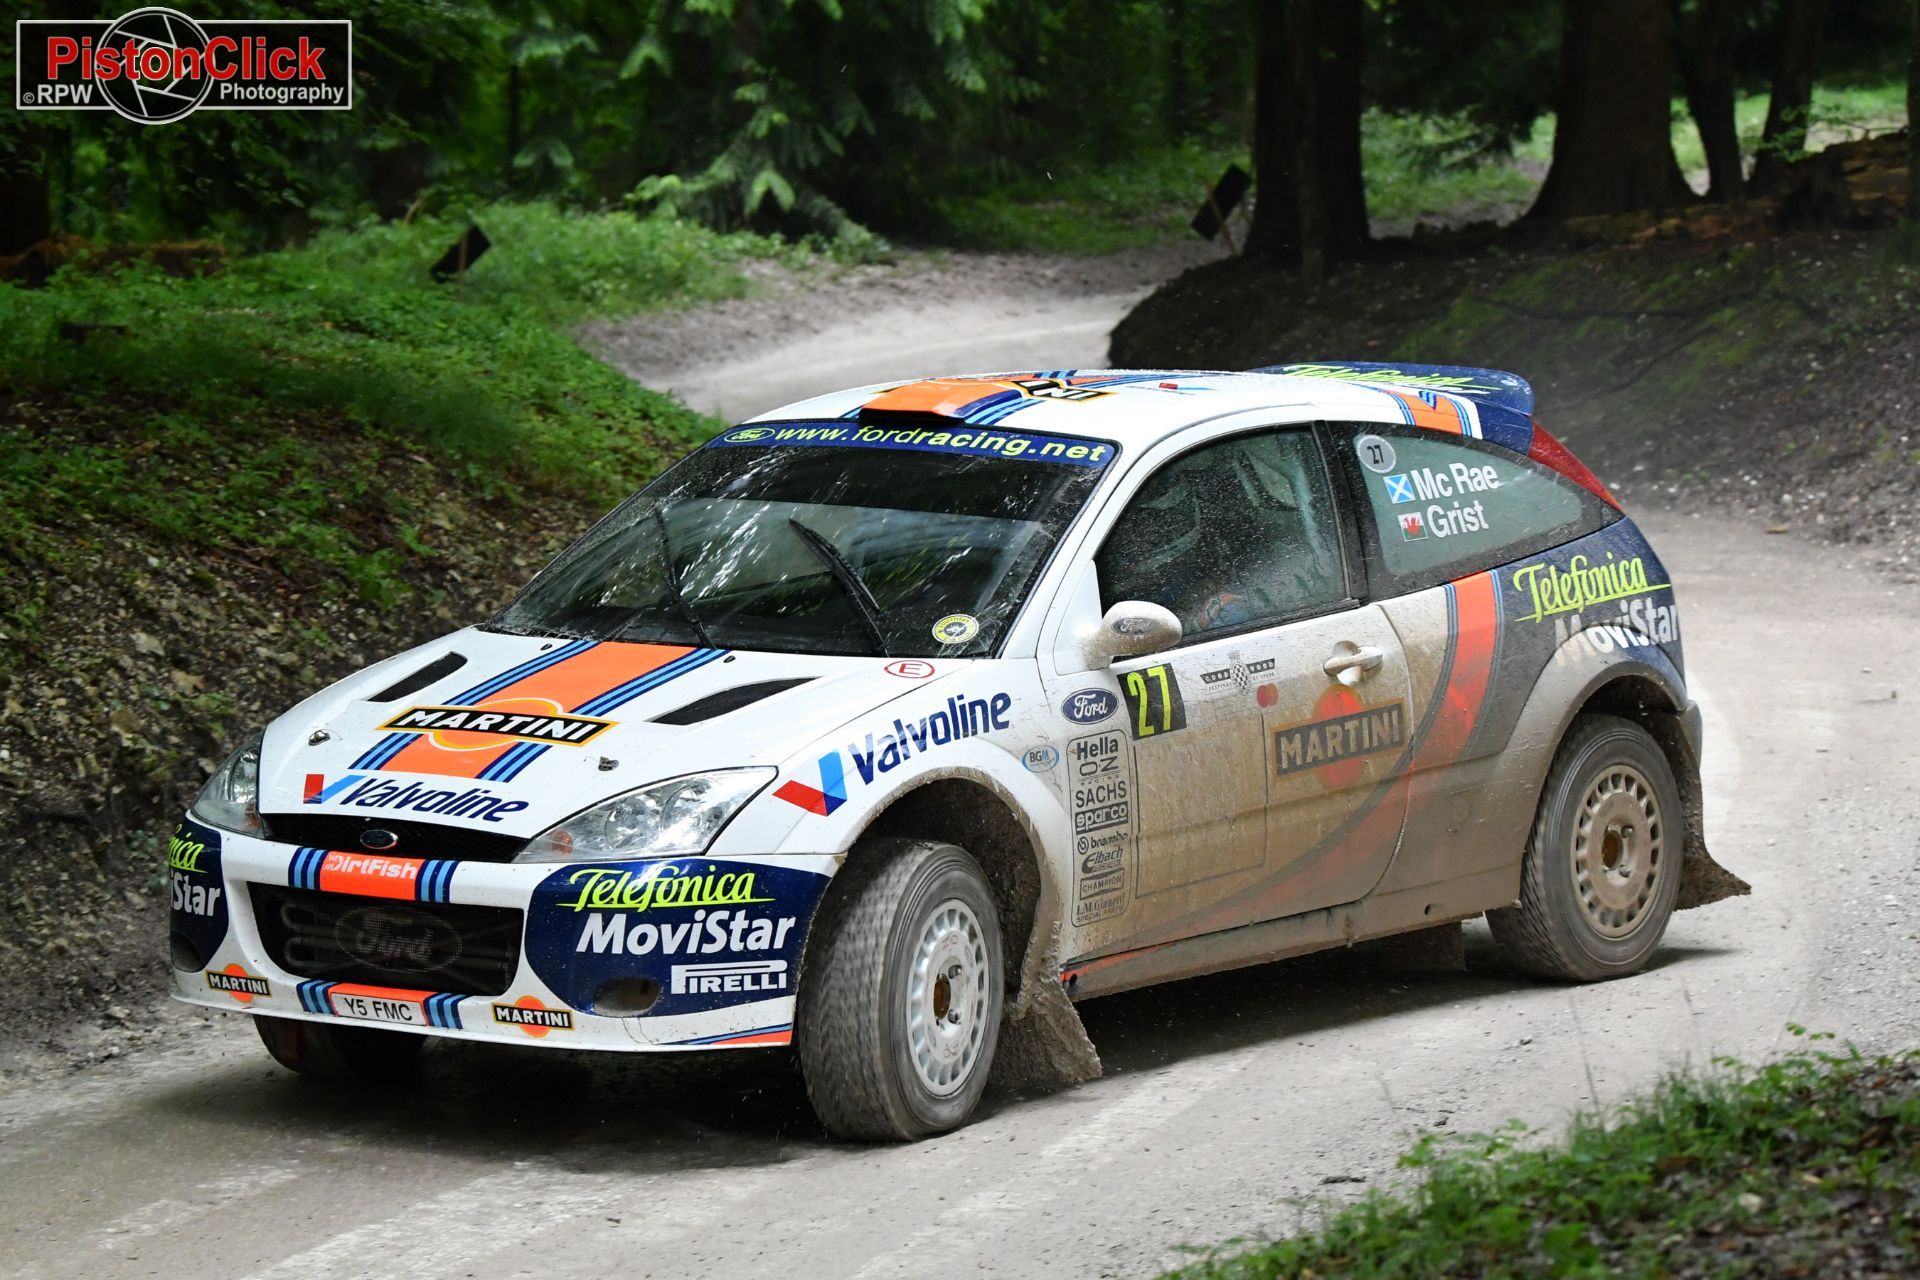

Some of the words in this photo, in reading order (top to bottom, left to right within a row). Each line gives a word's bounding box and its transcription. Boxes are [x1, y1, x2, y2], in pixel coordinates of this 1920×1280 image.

[775, 425, 1105, 462] www.fordracing.net
[1366, 444, 1385, 464] 27
[1410, 467, 1453, 501] Mc
[1449, 462, 1500, 494] Rae
[1427, 500, 1489, 538] Grist
[899, 663, 923, 675] E
[1074, 693, 1108, 718] Ford
[1127, 666, 1171, 737] 27
[396, 711, 597, 741] MARTINI
[848, 692, 1011, 786] Valvoline
[1280, 709, 1401, 769] MARTINI
[1029, 750, 1049, 763] BGM
[1077, 736, 1119, 760] Hella
[340, 778, 529, 822] Valvoline
[1075, 780, 1127, 808] SACHS
[1076, 804, 1127, 831] sparco
[323, 854, 418, 880] DirtFish
[1082, 875, 1122, 892] CHAMPION
[575, 908, 797, 956] MoviStar
[209, 974, 268, 995] MARTINI
[671, 959, 789, 995] PIRELLI
[344, 997, 368, 1017] Y5
[373, 1000, 413, 1022] FMC
[494, 1005, 569, 1028] MARTINI
